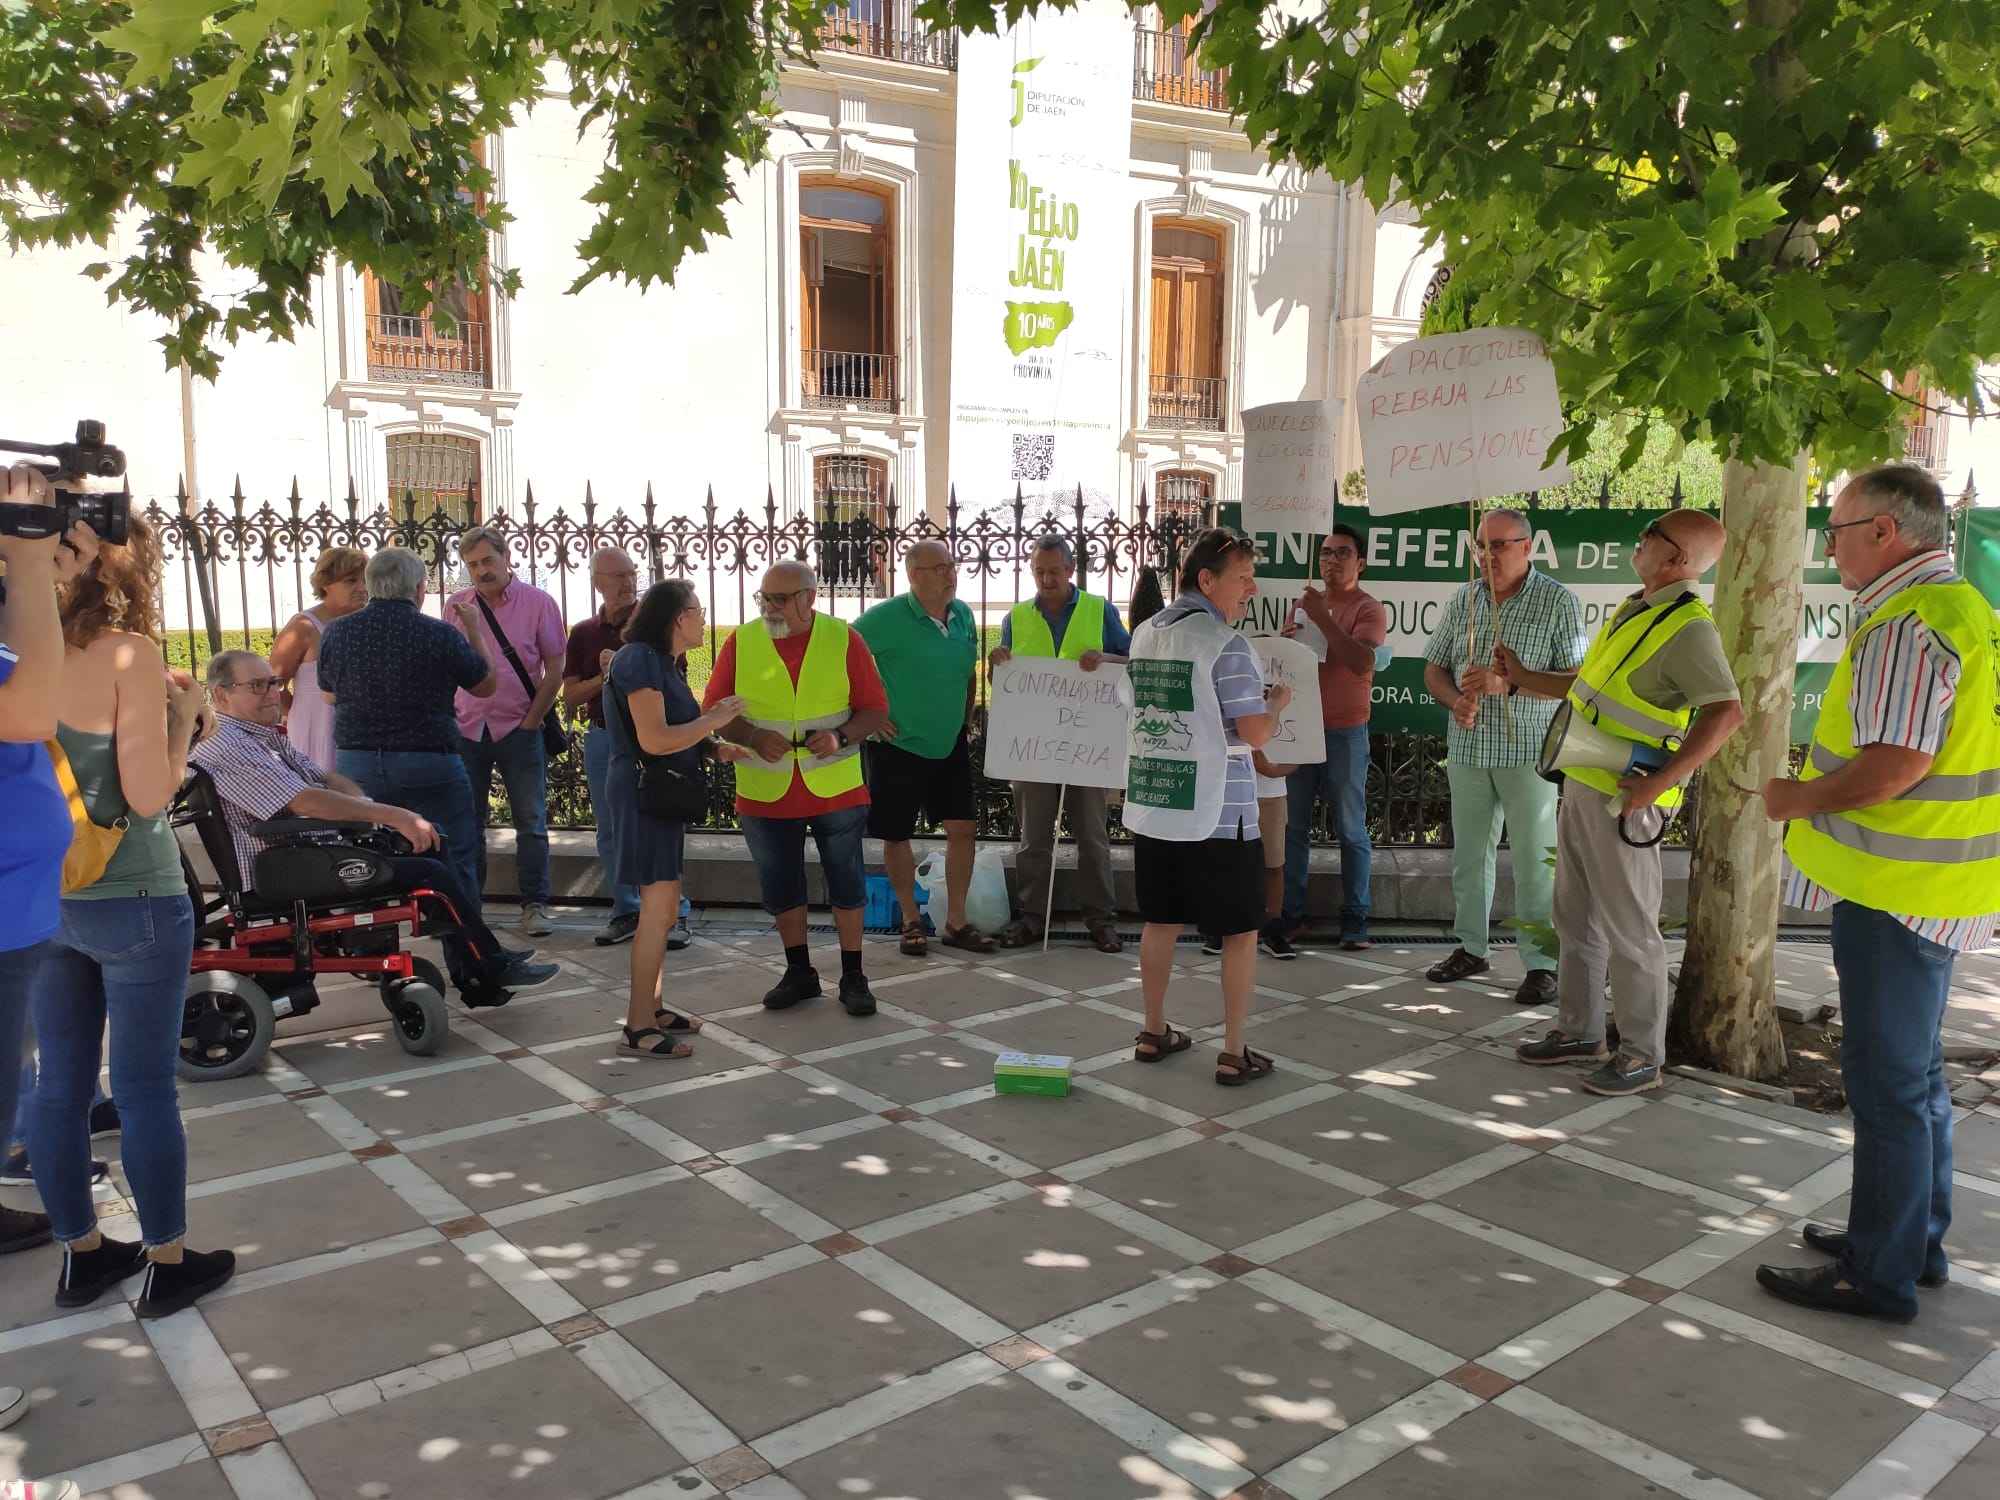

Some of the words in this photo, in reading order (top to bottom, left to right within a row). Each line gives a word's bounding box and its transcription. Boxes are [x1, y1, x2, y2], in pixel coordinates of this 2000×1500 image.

[1027, 90, 1085, 107] DIPUTACIÓN
[1027, 103, 1040, 113] DE
[1044, 105, 1066, 116] JAÉN
[1008, 233, 1065, 292] JAÉN
[1017, 312, 1037, 339] 10
[1037, 313, 1055, 330] AÑOS
[1013, 363, 1052, 380] PROVINCIA
[1371, 382, 1467, 420] REBAJA
[1484, 374, 1527, 400] LAS
[1250, 415, 1277, 432] QUE
[1389, 425, 1555, 479] PENSIONES
[1576, 541, 1620, 569] DE
[1058, 707, 1090, 727] DE
[1008, 736, 1111, 770] MISERIA
[1156, 762, 1195, 774] PUBLICAS
[1151, 776, 1175, 789] JUSTAS
[1178, 779, 1185, 790] Y
